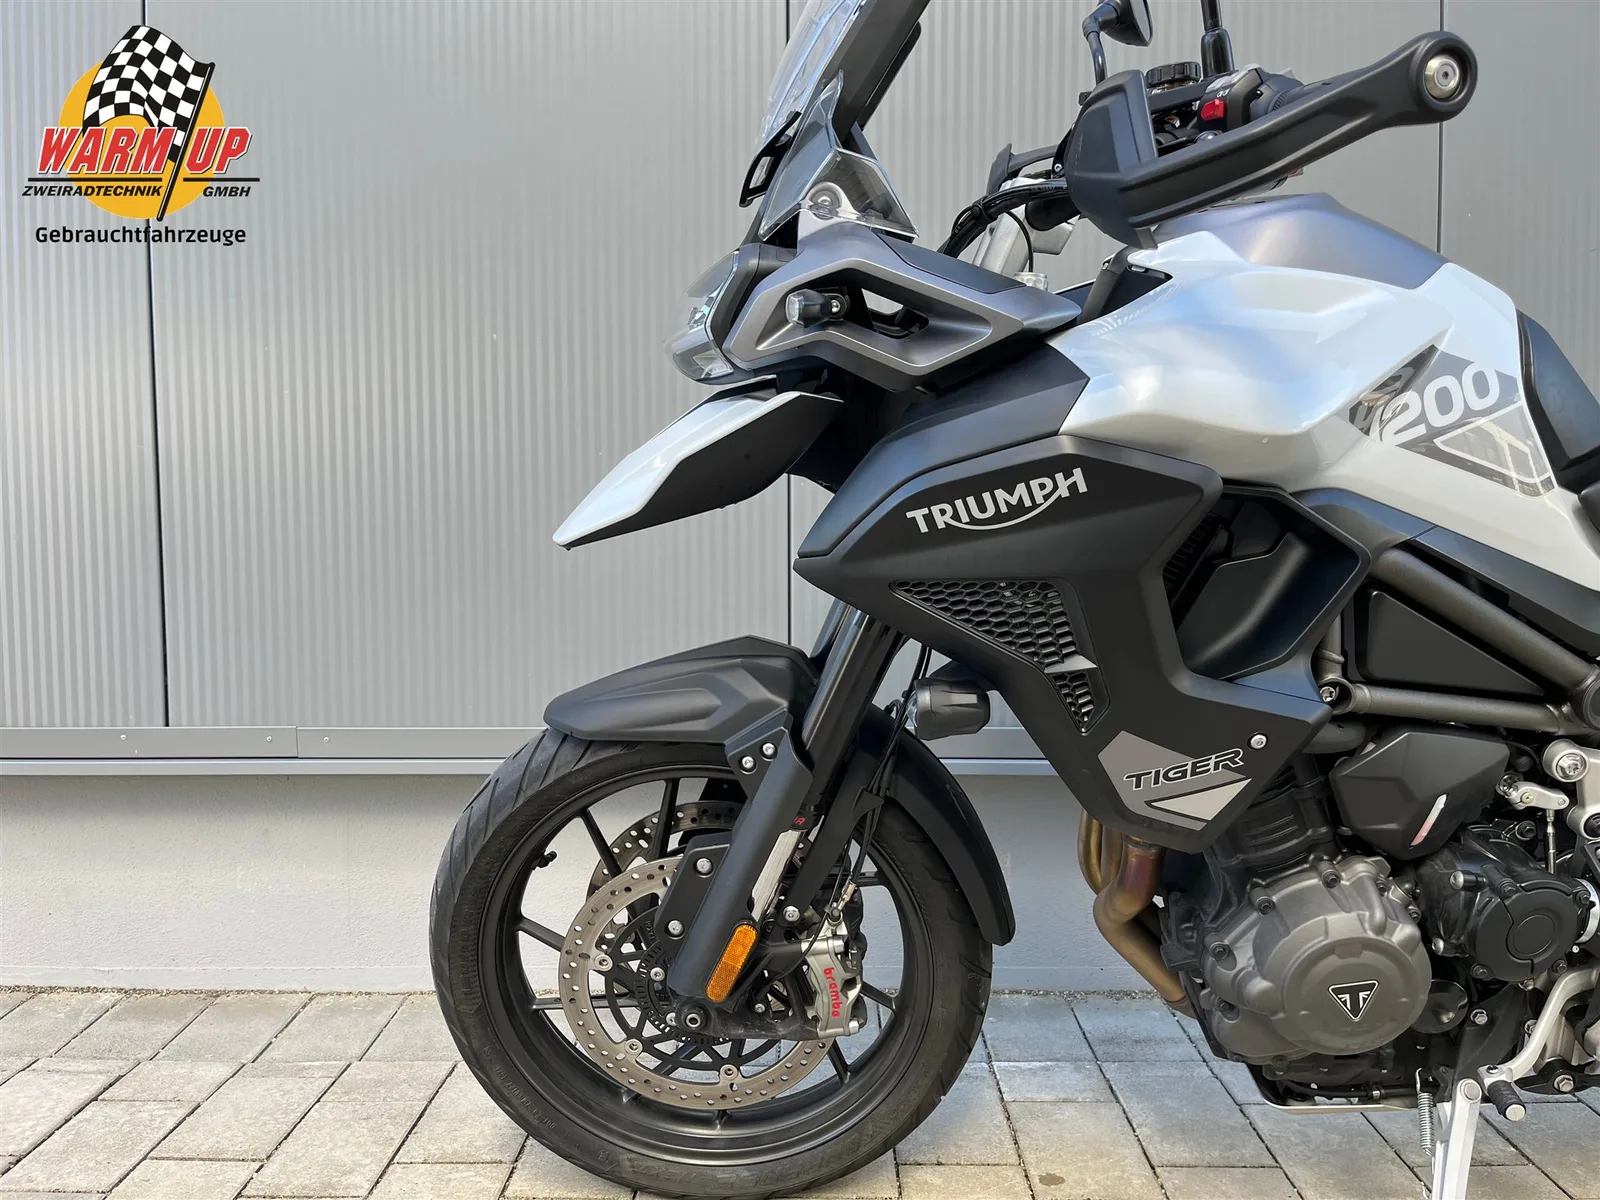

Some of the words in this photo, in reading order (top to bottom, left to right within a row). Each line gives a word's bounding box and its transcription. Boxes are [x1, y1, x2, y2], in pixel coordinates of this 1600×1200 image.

[905, 467, 1088, 533] TRIUMPH
[1123, 748, 1244, 791] TIGER
[823, 967, 843, 1018] brembo
